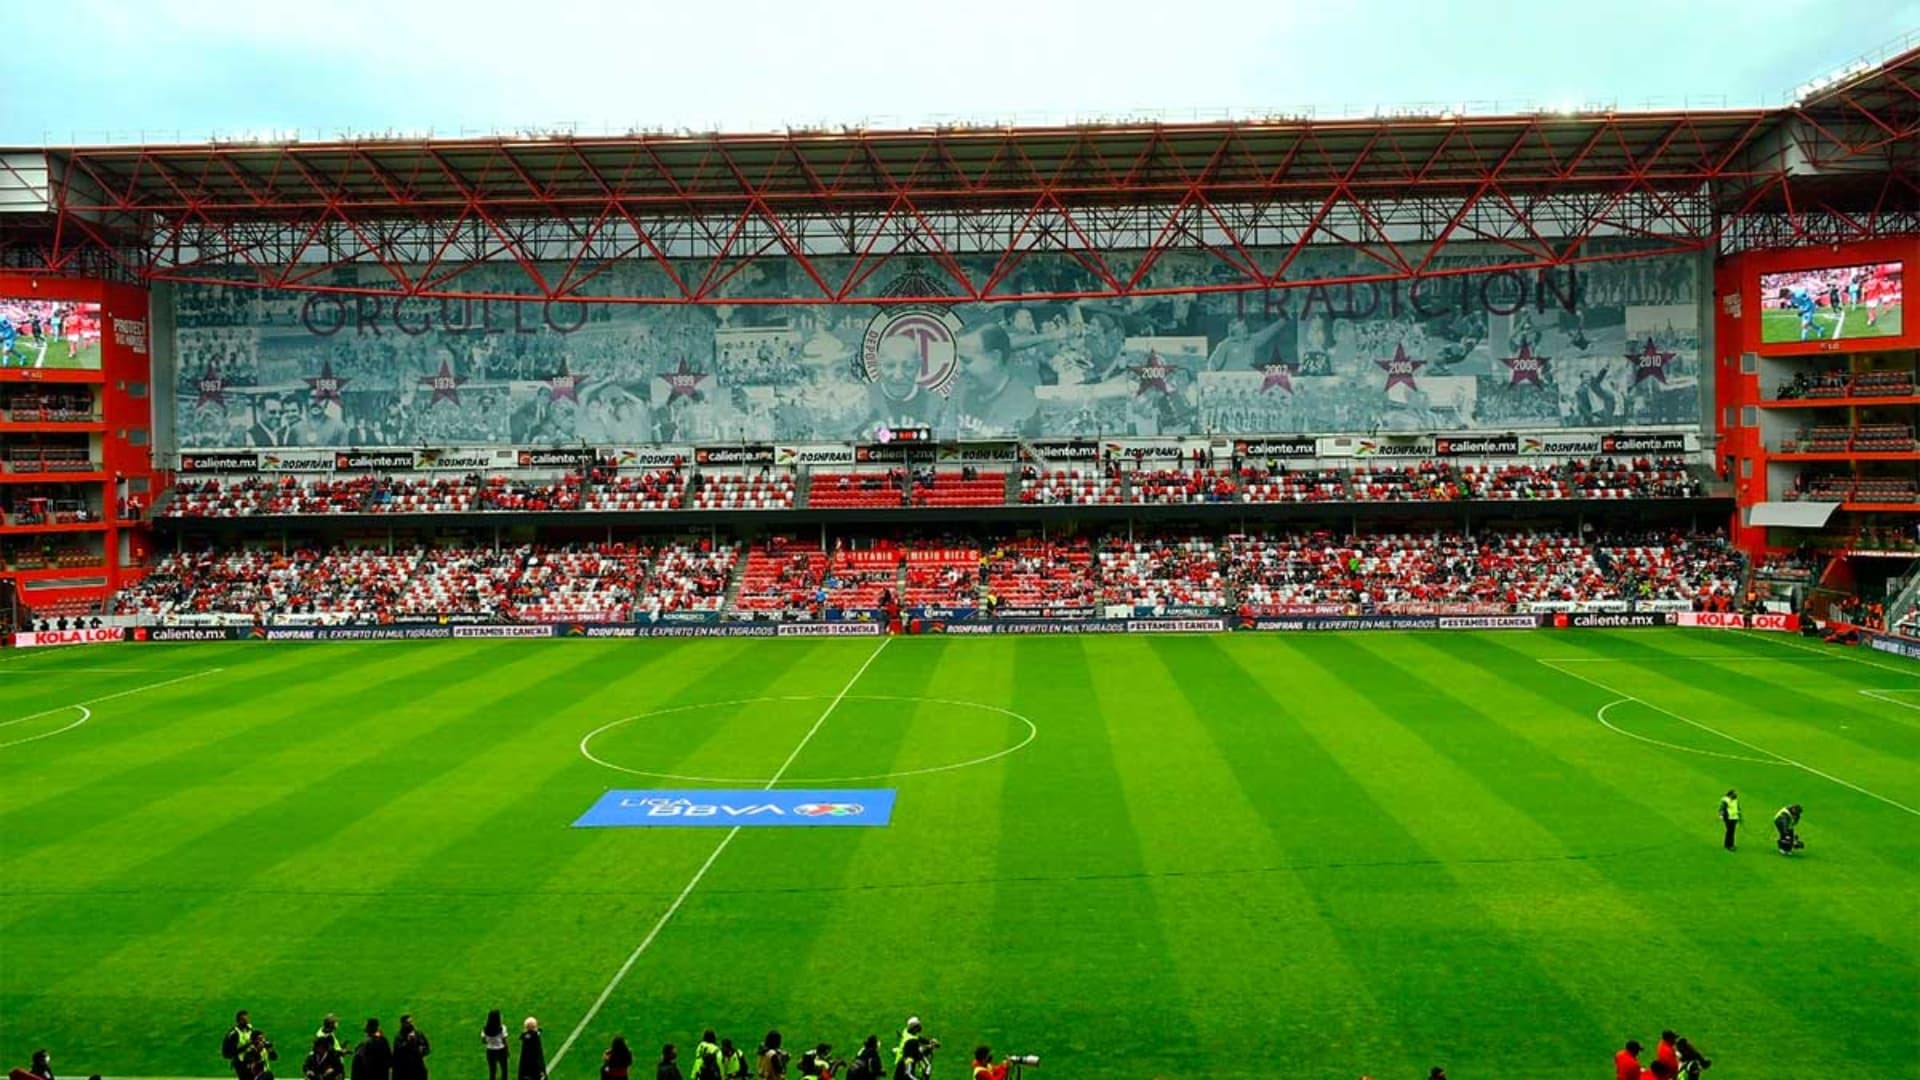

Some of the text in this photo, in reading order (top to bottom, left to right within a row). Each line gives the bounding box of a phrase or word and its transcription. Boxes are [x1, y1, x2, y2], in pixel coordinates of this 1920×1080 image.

[303, 289, 588, 336] ORGULLO
[1639, 355, 1663, 367] 2010
[1248, 442, 1314, 454] caliente.mx
[1378, 445, 1433, 455] ROSHFRANS
[1449, 441, 1517, 453] caliente.mx
[1544, 442, 1599, 453] ROSHFRANS
[1615, 438, 1683, 450] caliente.mx
[195, 457, 257, 468] caliente.mx
[348, 456, 412, 467] caliente.mx
[437, 457, 489, 467] ROSHFRANS
[800, 452, 852, 461] ROSHFRANS
[1574, 615, 1654, 627] caliente.mx
[1696, 614, 1743, 627] KOLA
[35, 631, 82, 645] KOLA
[153, 628, 226, 640] caliente.mx
[620, 797, 692, 808] LIGA
[648, 804, 785, 817] BBVA
